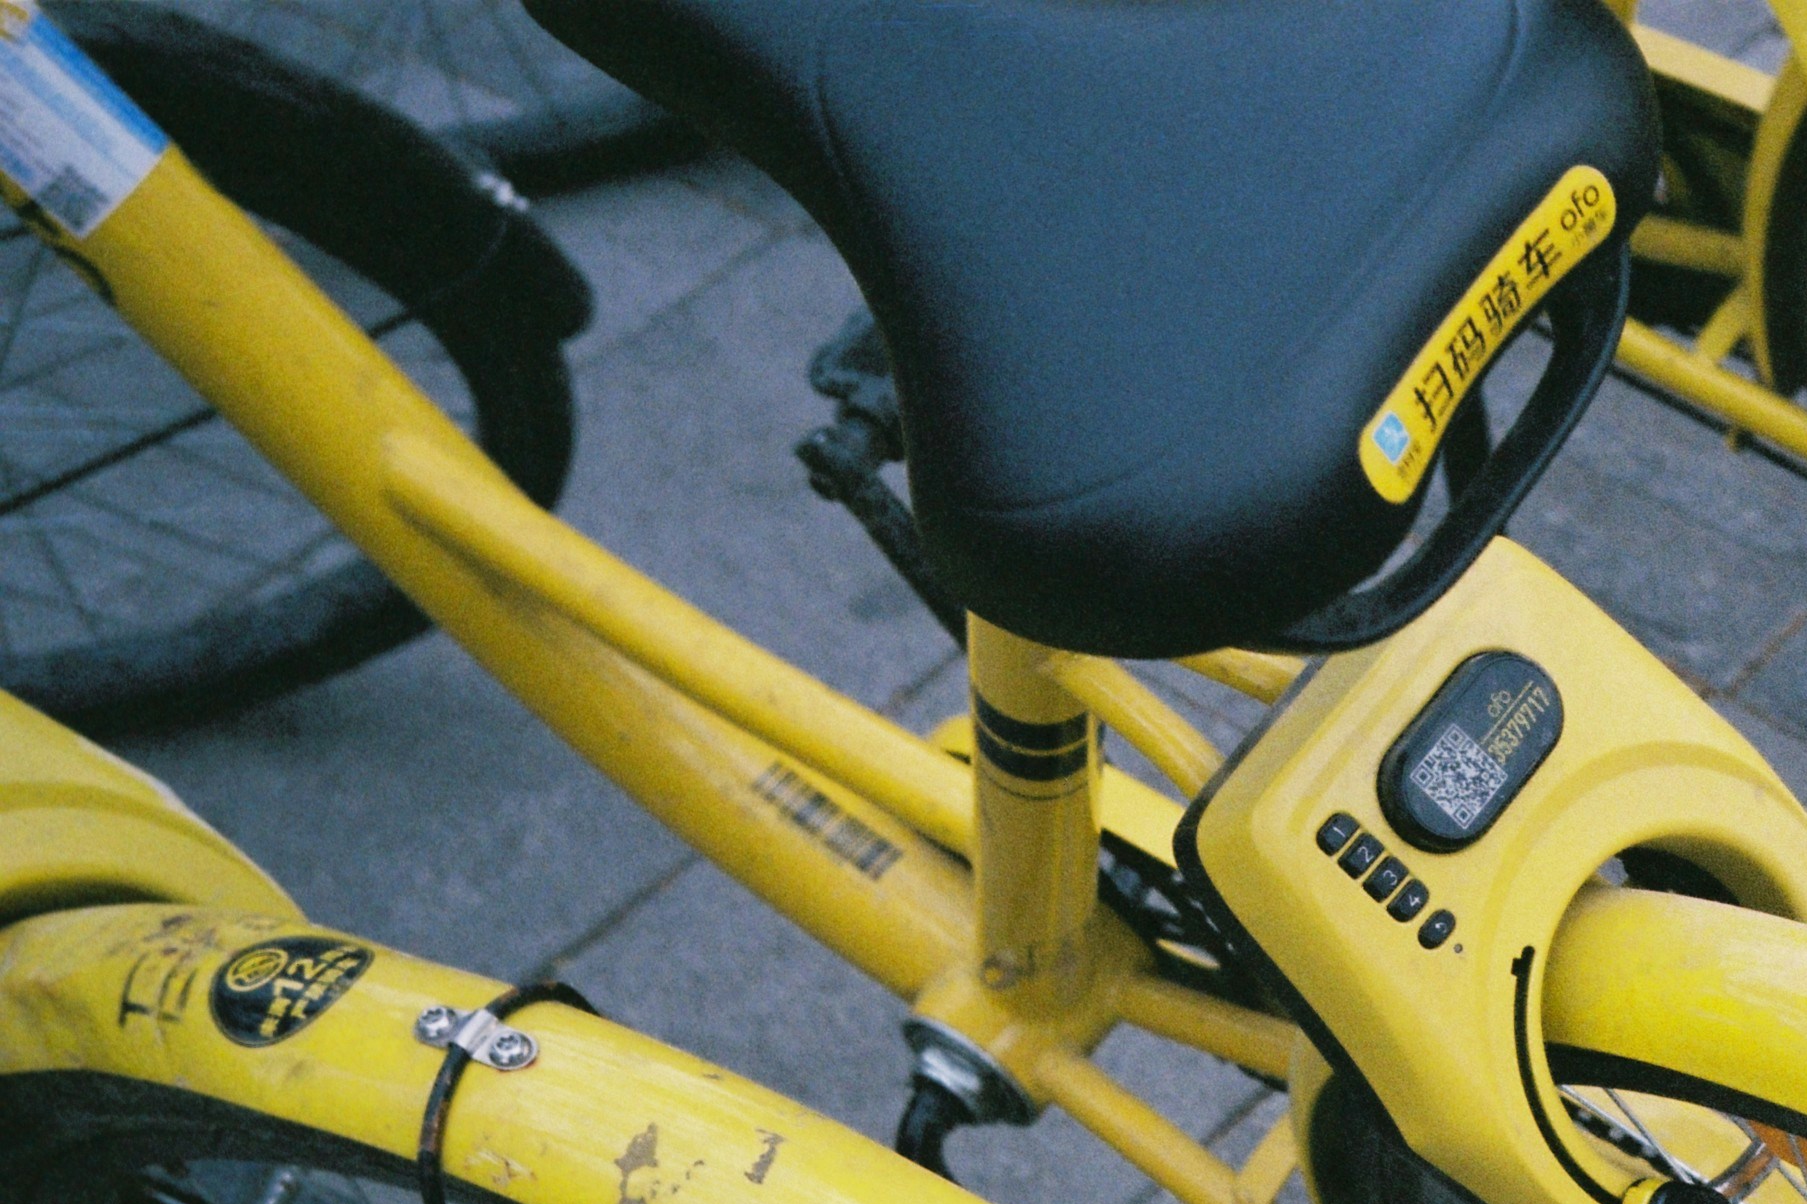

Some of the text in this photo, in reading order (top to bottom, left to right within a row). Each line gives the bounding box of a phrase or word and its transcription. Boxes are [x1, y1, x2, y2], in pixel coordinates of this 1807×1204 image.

[1560, 185, 1601, 232] ofo
[1411, 228, 1563, 433] 扫码骑车
[1487, 690, 1512, 718] ofo
[1487, 686, 1550, 766] 35379717
[1357, 846, 1375, 863] 2
[1383, 869, 1398, 886] 3
[1408, 893, 1422, 908] 4
